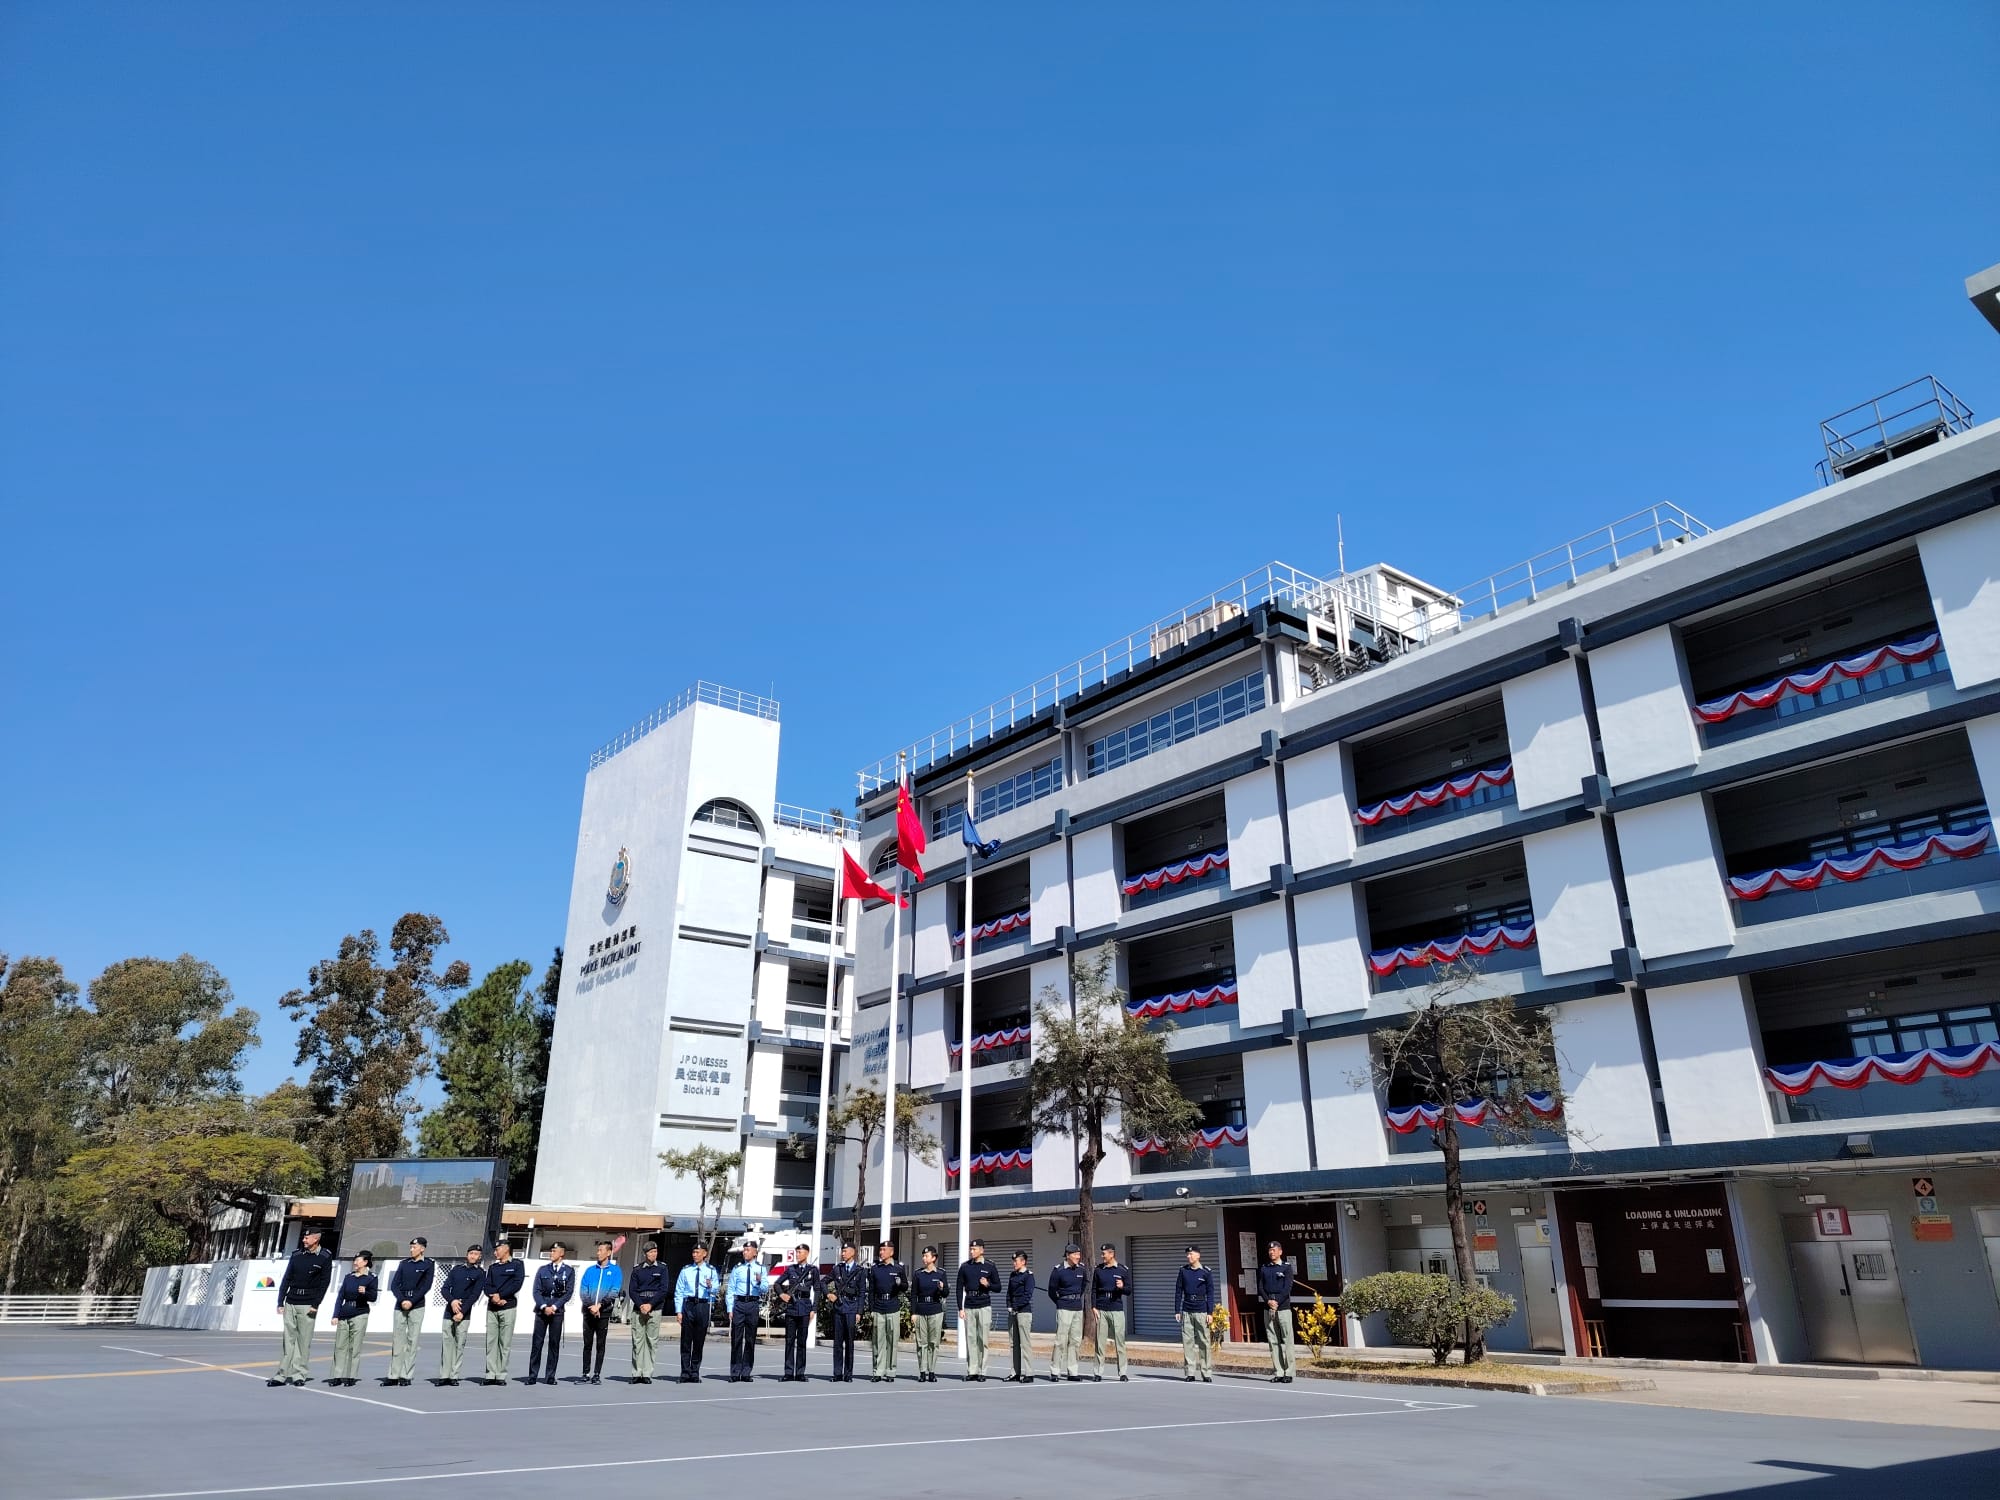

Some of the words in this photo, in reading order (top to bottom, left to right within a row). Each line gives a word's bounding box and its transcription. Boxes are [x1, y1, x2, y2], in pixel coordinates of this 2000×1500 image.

[626, 941, 642, 956] UNIT
[699, 1057, 728, 1068] MESSES
[682, 1084, 704, 1095] Block
[1920, 1183, 1927, 1191] 4
[1625, 1210, 1662, 1220] LOADING
[1664, 1210, 1672, 1219] &
[1280, 1223, 1305, 1231] LOADING
[787, 1250, 794, 1262] 5
